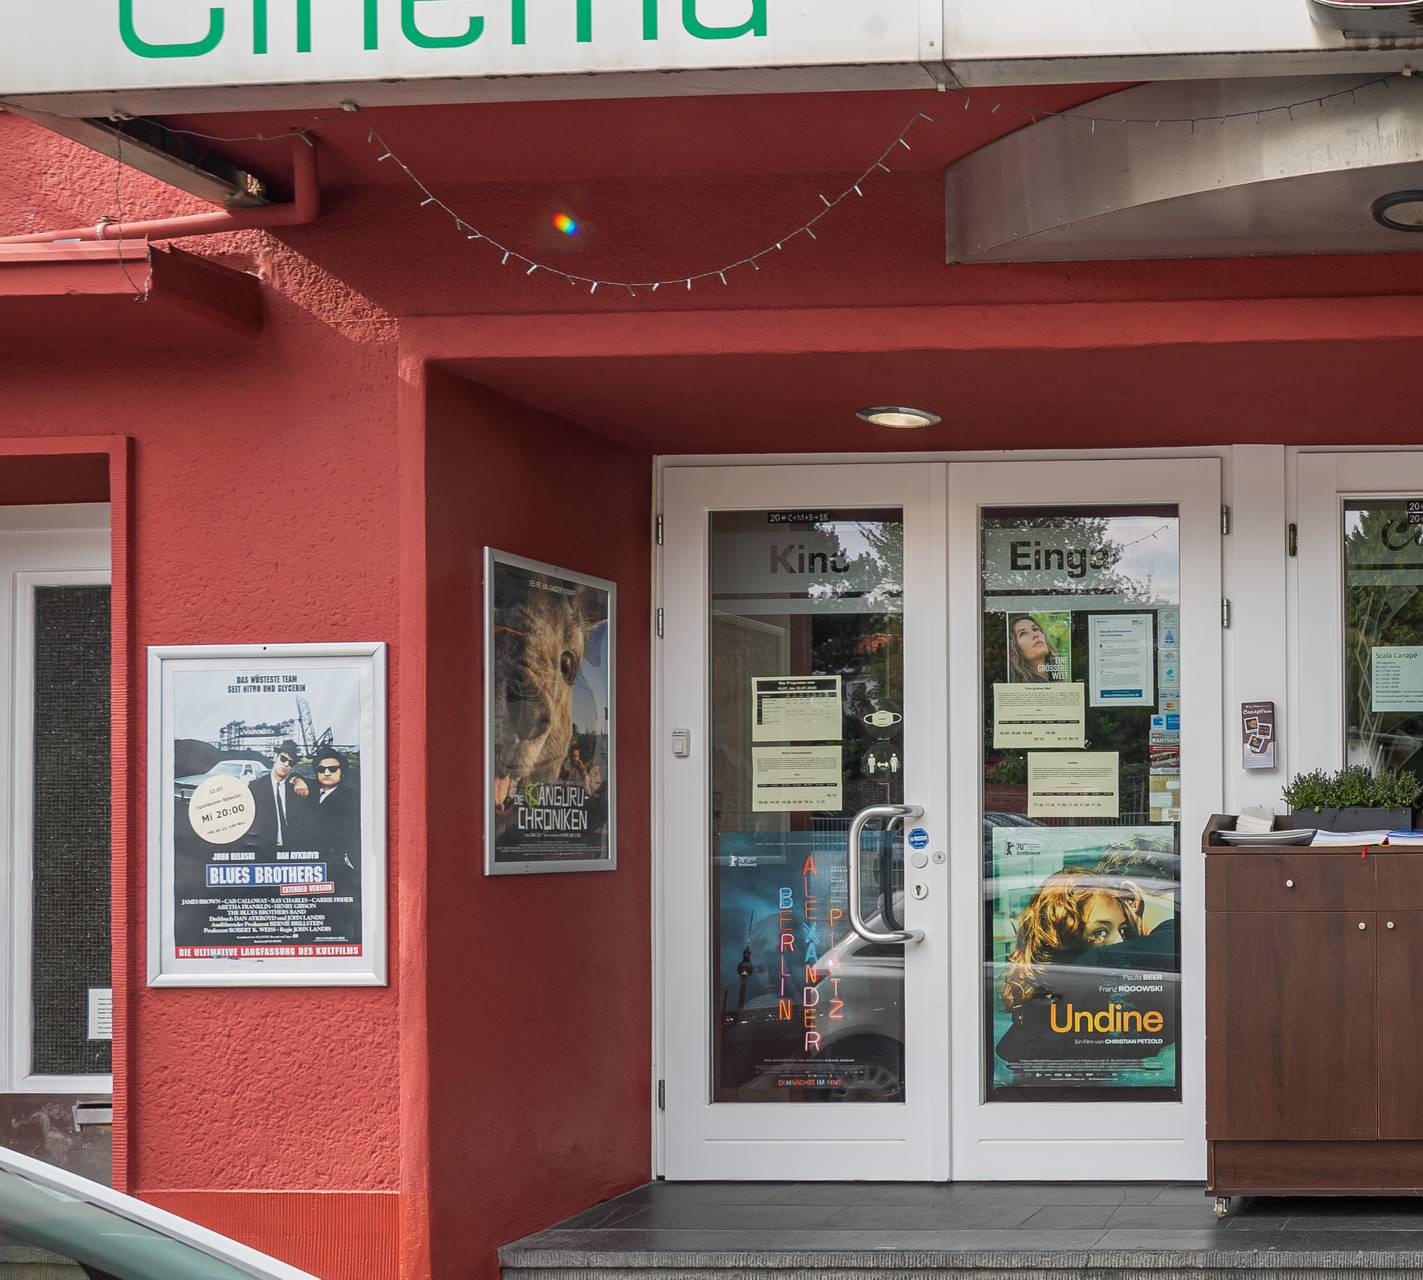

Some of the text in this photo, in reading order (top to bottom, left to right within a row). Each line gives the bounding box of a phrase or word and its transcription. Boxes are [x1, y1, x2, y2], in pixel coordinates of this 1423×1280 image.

[1055, 656, 1069, 664] EINE
[1393, 652, 1418, 660] Canapé
[1037, 664, 1069, 672] GRÖSSERE
[236, 674, 298, 684] DAS WÜSTESTE TEAM
[1052, 672, 1069, 680] WELT
[227, 683, 306, 694] SEIT NITRO UND GLYCERIN
[202, 804, 245, 823] Mi 20:00
[518, 807, 588, 830] CHRONIKEN
[209, 866, 323, 884] BLUES BROTHERS
[178, 945, 359, 957] DIE ULTIMATIVE LANGFASSUNG DES KULTFILMS
[1099, 985, 1118, 993] Franz
[1050, 1003, 1164, 1033] Undine
